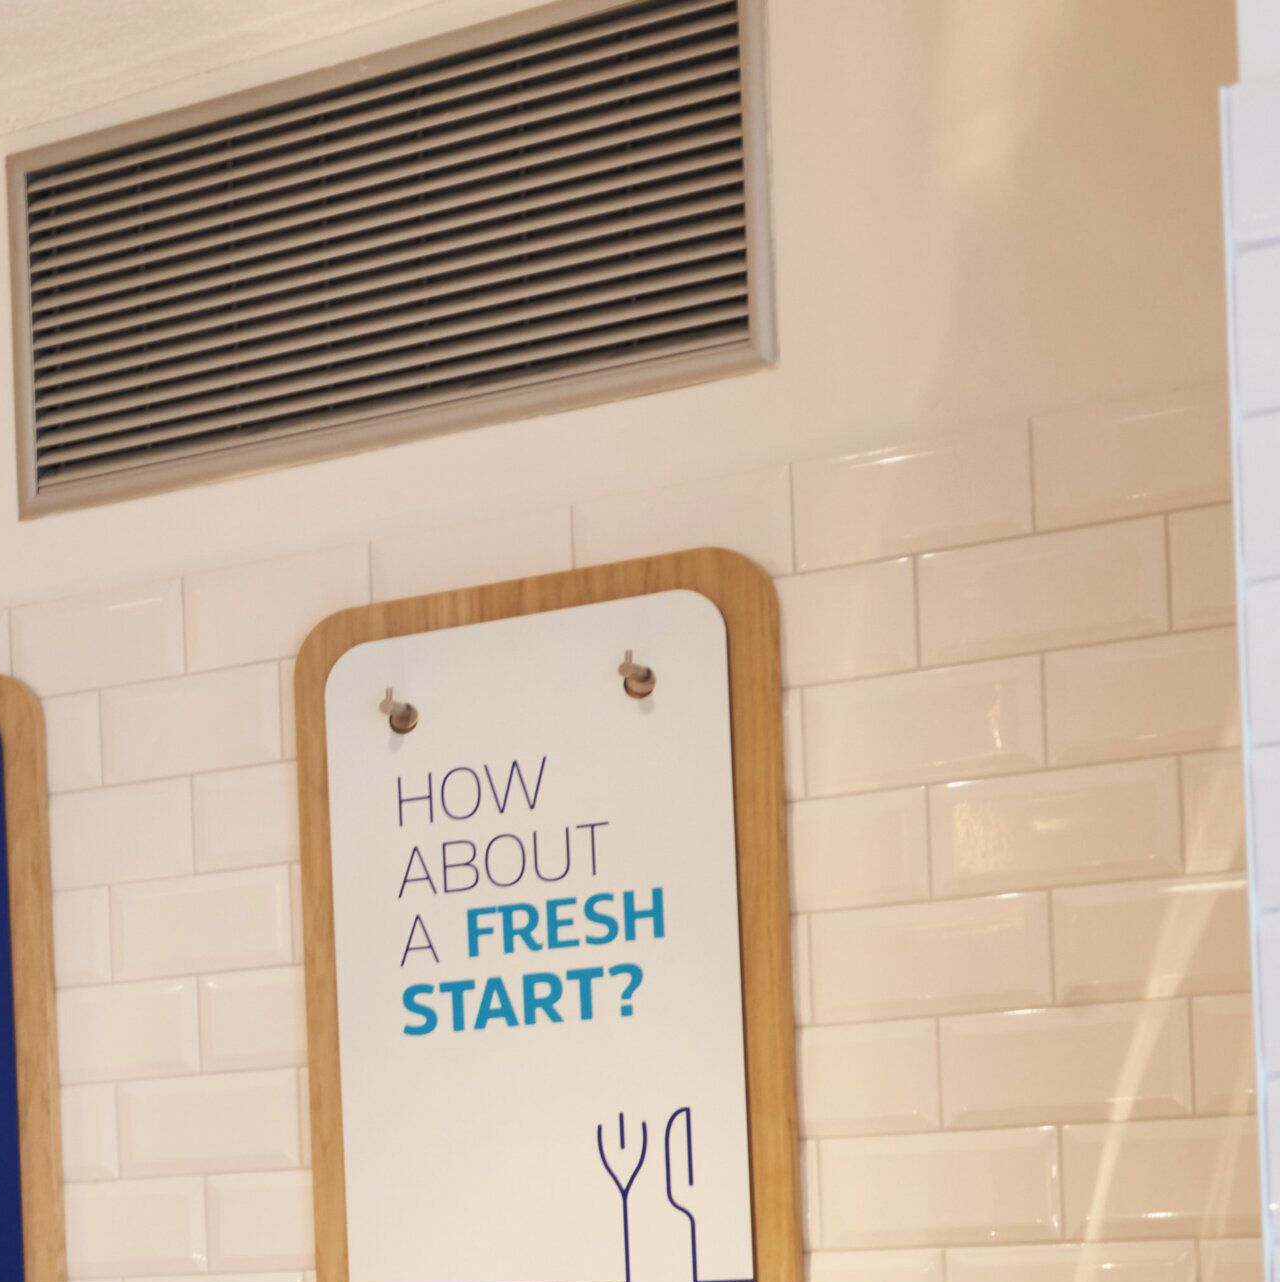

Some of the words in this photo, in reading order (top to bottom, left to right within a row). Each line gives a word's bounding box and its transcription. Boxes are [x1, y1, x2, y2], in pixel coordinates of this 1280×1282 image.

[397, 756, 547, 827] HOW
[398, 821, 610, 900] ABOUT
[400, 914, 440, 967] A
[466, 886, 665, 958] FRESH
[401, 963, 644, 1036] START?
